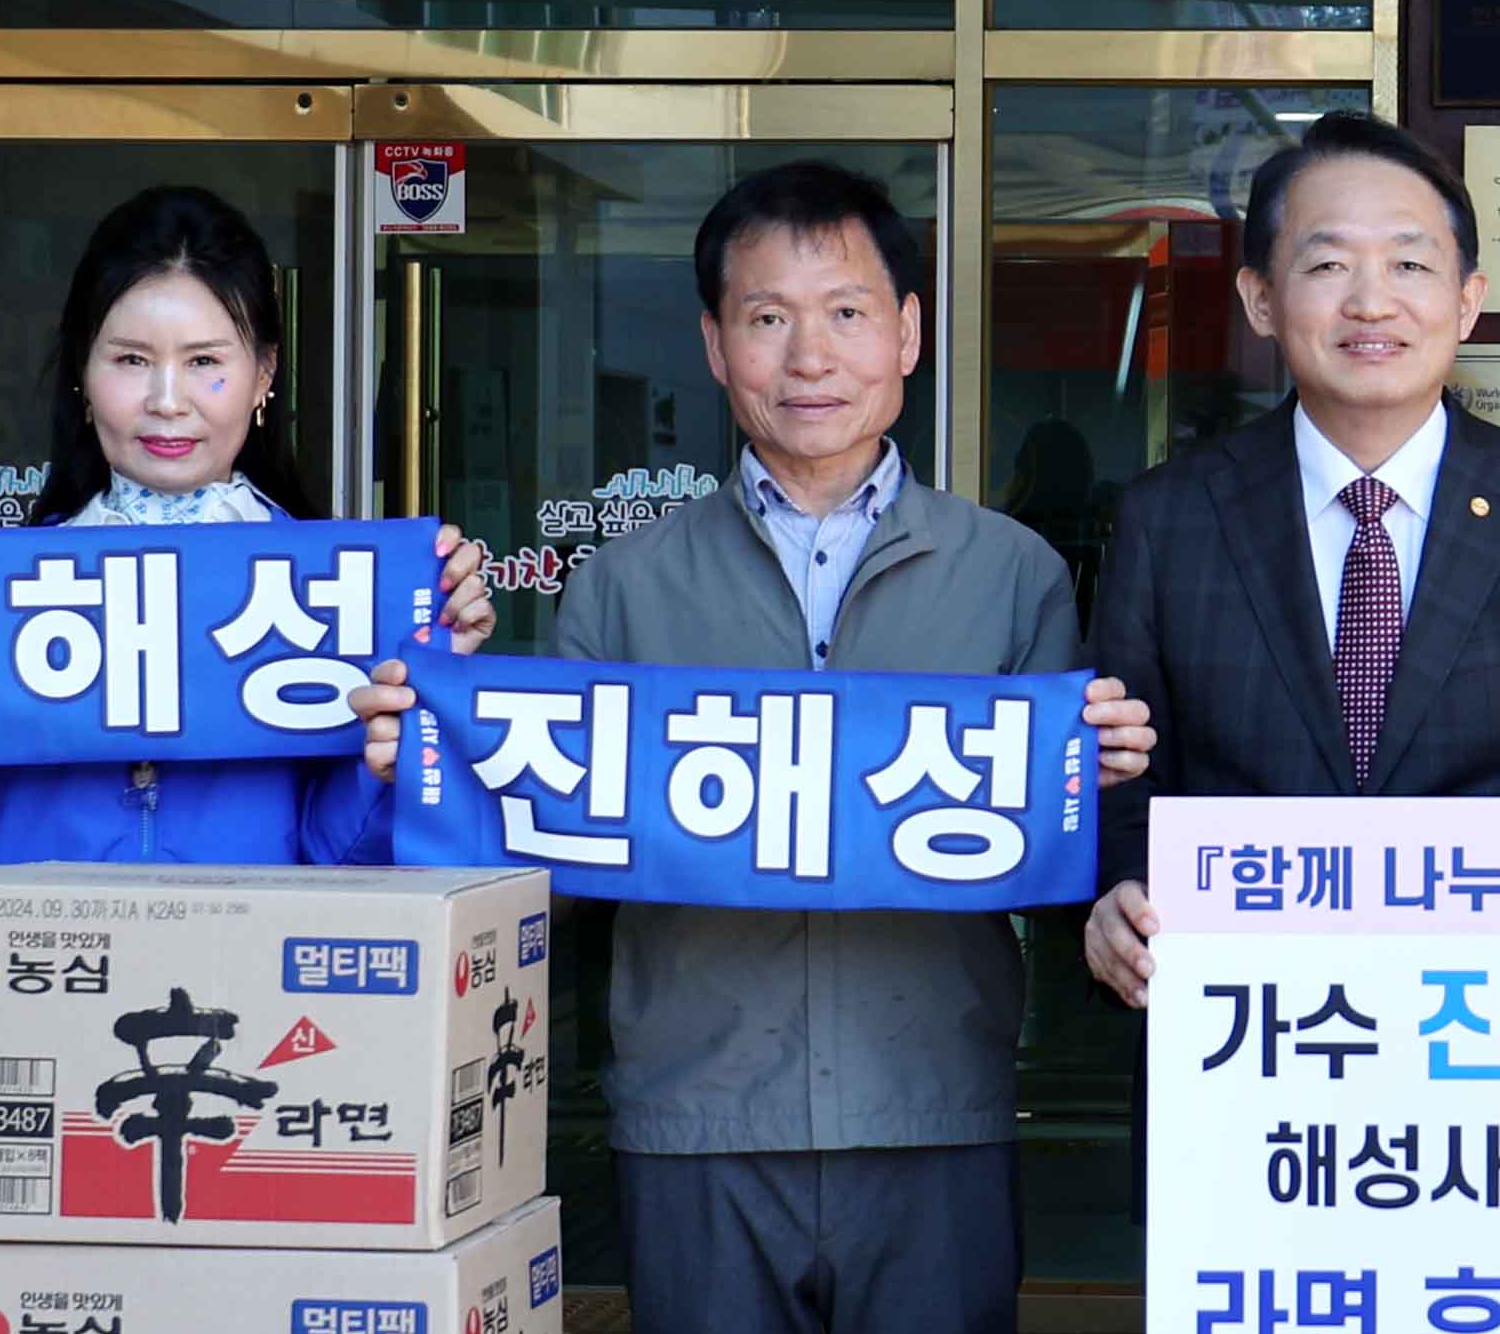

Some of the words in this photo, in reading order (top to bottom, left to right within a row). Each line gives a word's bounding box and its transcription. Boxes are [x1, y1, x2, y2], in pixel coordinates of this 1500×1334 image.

[385, 146, 420, 156] CCTV
[398, 184, 443, 200] BOSS
[538, 501, 596, 537] 살고
[471, 681, 1031, 882] 진해성
[1202, 982, 1379, 1079] 가수
